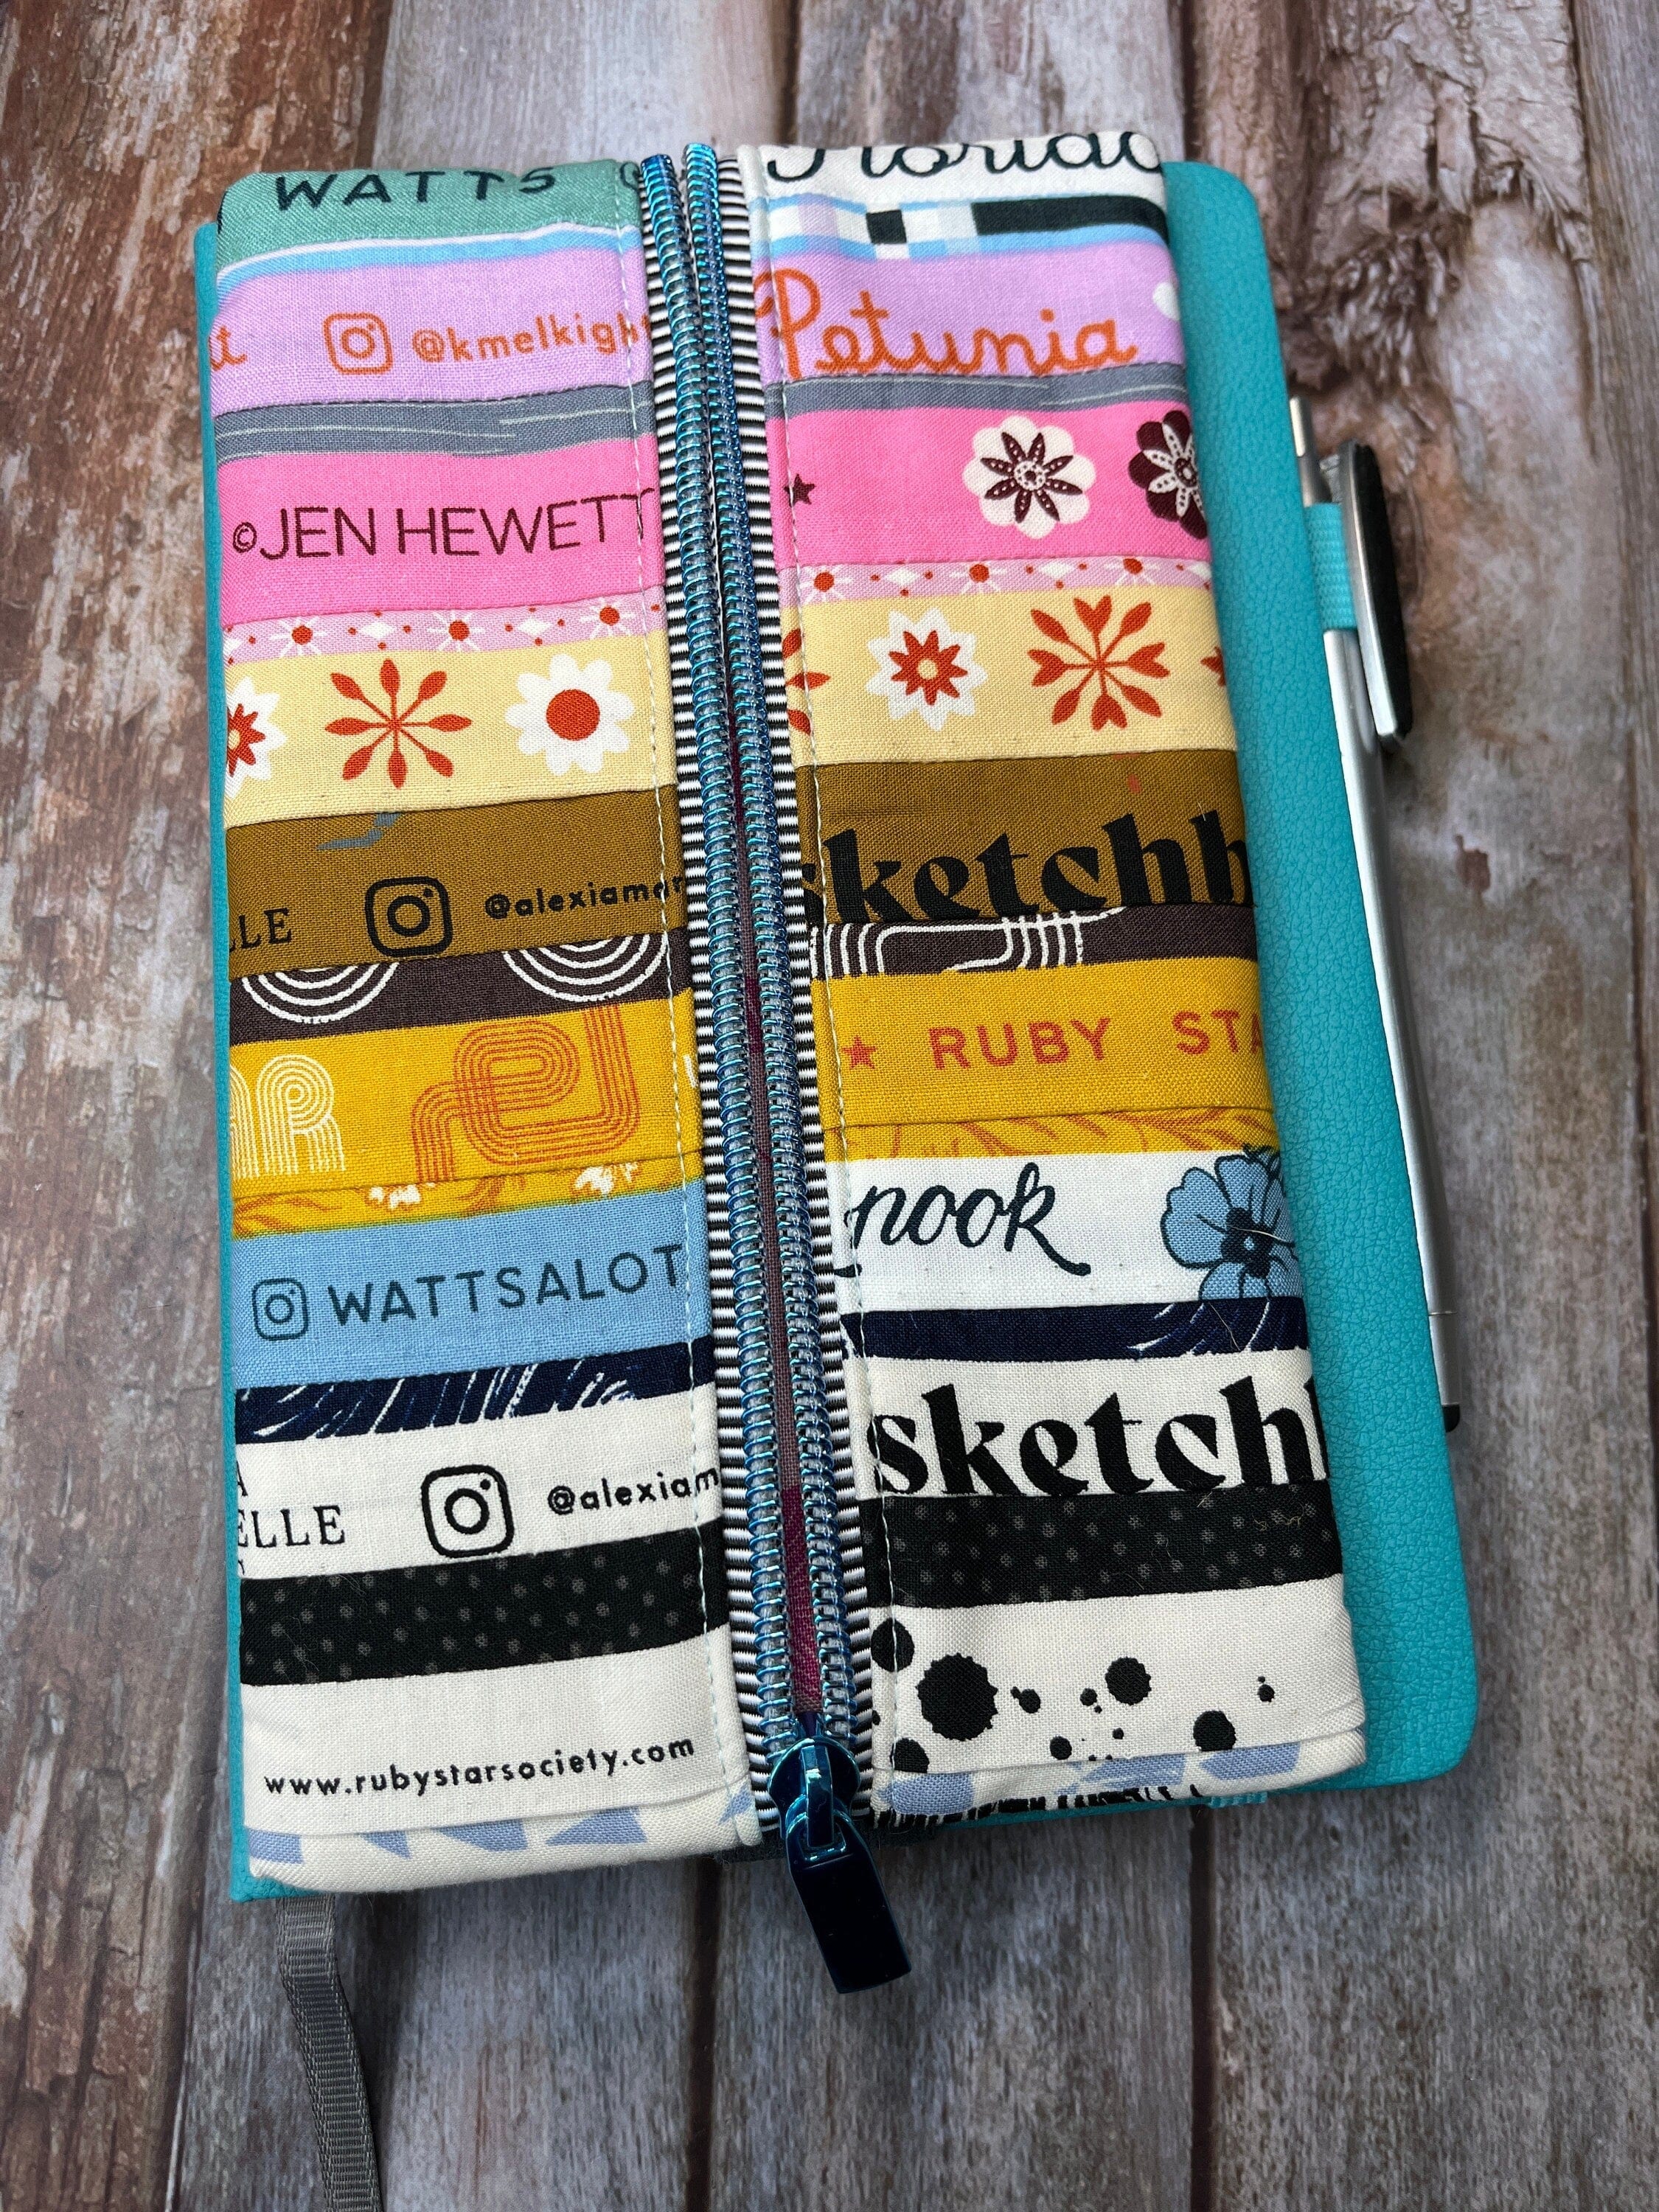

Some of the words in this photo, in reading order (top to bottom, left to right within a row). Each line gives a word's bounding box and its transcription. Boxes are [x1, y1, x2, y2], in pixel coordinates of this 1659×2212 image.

[275, 167, 557, 212] WATTS
[753, 268, 1137, 381] Petunia
[398, 488, 655, 557] HEWETT
[229, 907, 293, 953] LE
[928, 1017, 1110, 1070] RUBY
[327, 1243, 683, 1326] WATTSALOT
[547, 1467, 719, 1516] @alexiam
[264, 1737, 695, 1797] www.rubystarsociety.com
